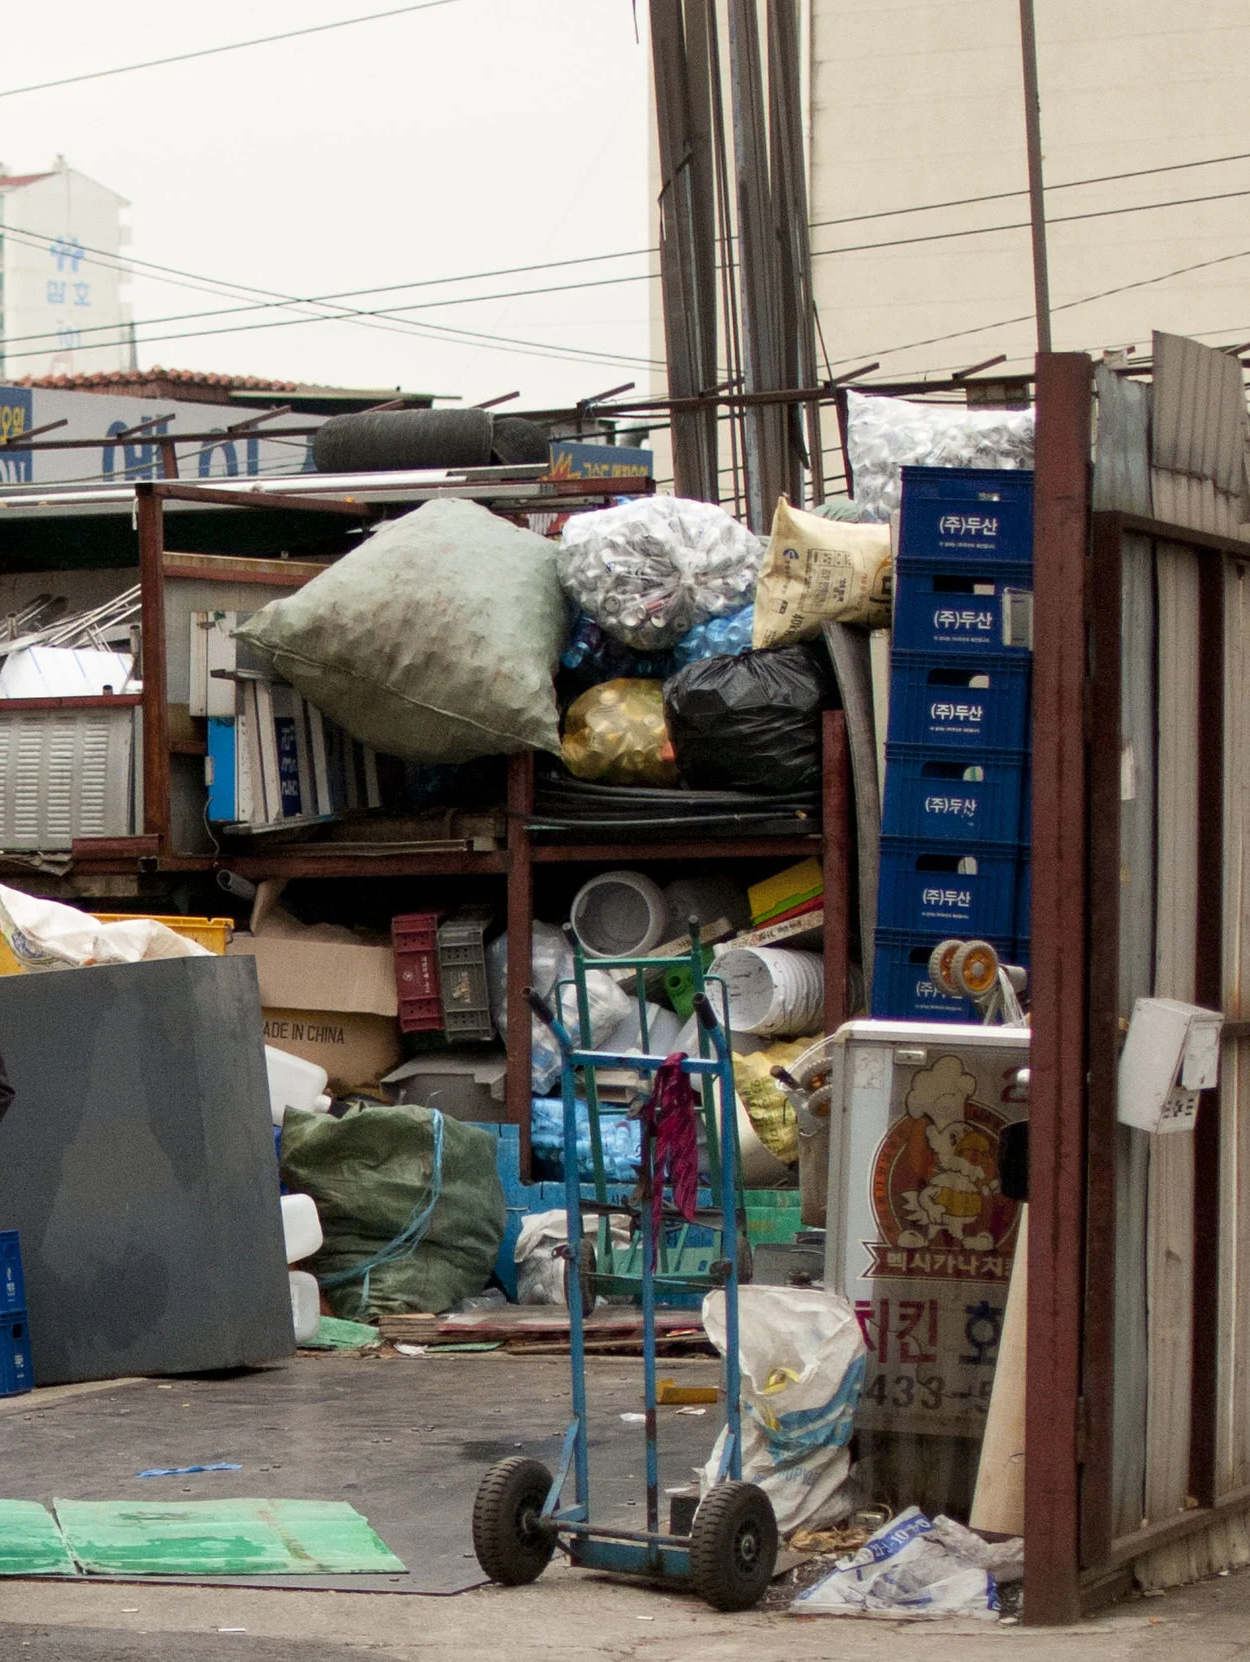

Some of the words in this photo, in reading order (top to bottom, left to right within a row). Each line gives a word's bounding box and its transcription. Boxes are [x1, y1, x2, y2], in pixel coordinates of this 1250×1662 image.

[939, 516, 998, 536] (주)두산
[934, 610, 992, 630] (주)두산
[931, 703, 982, 722] (주)두산
[923, 888, 971, 908] (주)두산
[292, 1023, 303, 1041] IN
[307, 1026, 345, 1045] CHINA
[854, 1298, 937, 1364] 치킨
